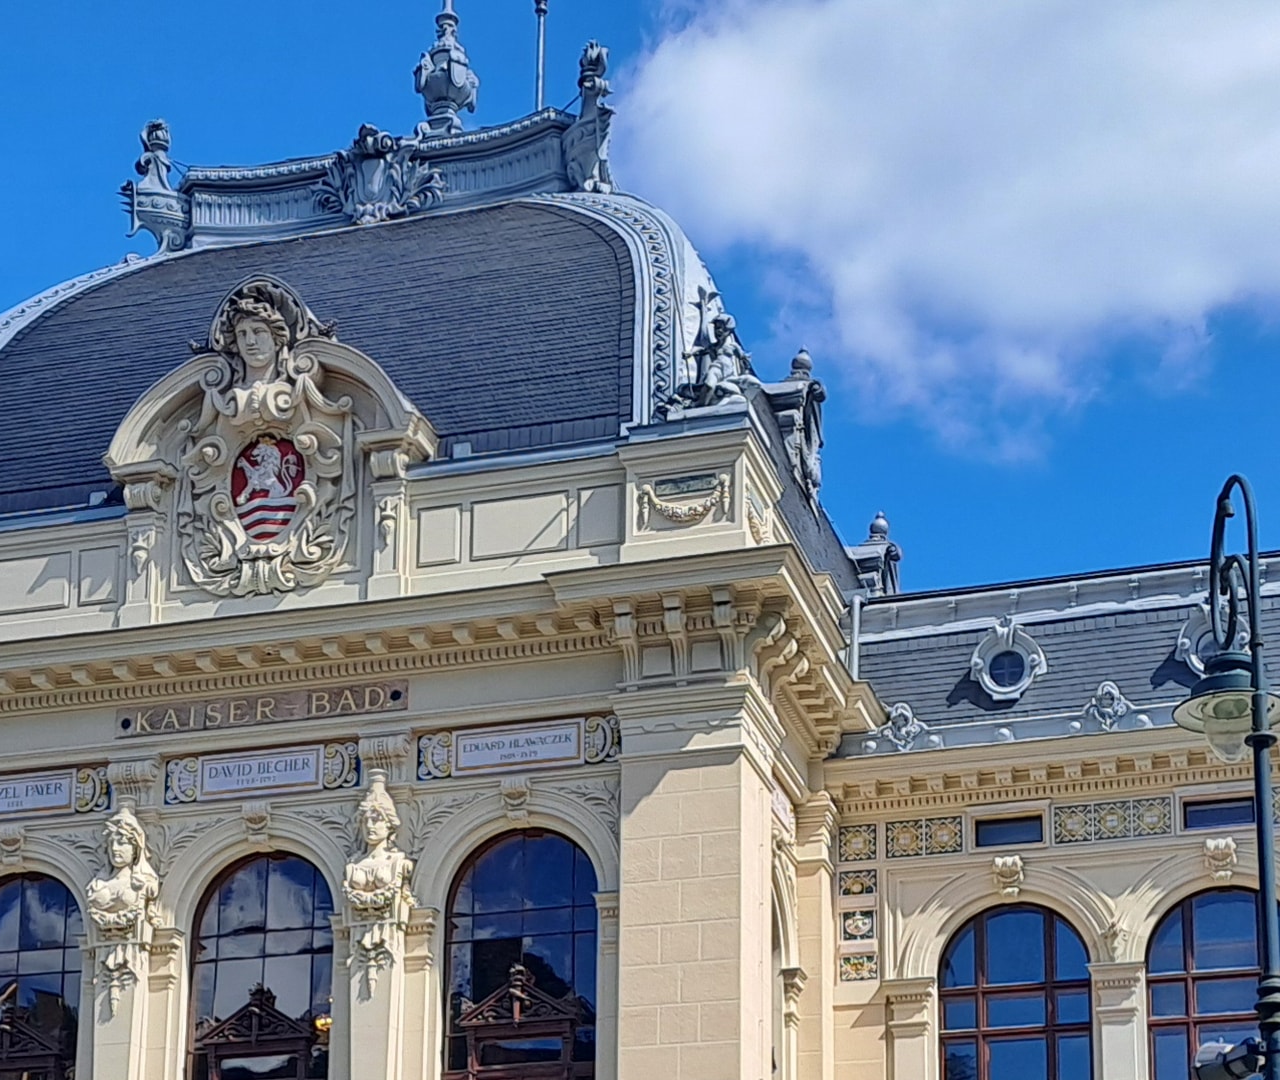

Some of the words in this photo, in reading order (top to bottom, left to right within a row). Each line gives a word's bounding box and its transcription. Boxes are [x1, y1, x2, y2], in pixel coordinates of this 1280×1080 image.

[462, 740, 505, 753] EDUARD
[208, 763, 253, 779] DAVID
[257, 757, 312, 775] BECHER
[24, 781, 64, 797] PAYER
